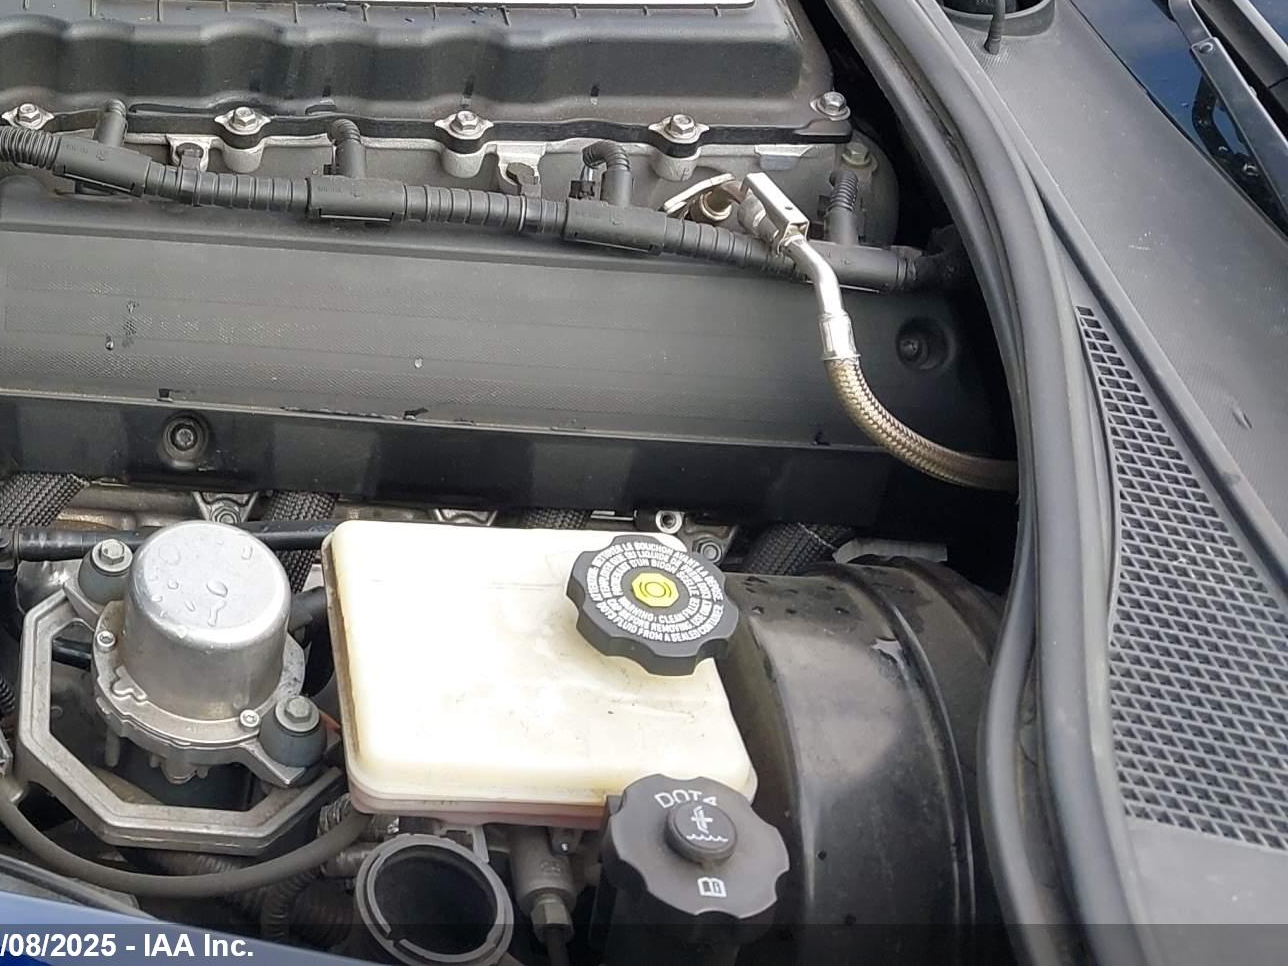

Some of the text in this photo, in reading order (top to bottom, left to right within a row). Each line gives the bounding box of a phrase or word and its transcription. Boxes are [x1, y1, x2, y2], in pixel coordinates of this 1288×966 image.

[633, 541, 673, 555] BOUCHON
[674, 551, 701, 569] AVANT
[696, 566, 709, 577] LA
[651, 559, 678, 574] BIDON
[618, 609, 650, 630] BEFORE
[690, 612, 708, 626] USE
[658, 613, 686, 624] CLEAN
[682, 597, 700, 619] FILLER
[613, 616, 638, 634] FLUID
[637, 627, 663, 641] FROM
[664, 632, 671, 642] A
[671, 629, 701, 642] SEALED
